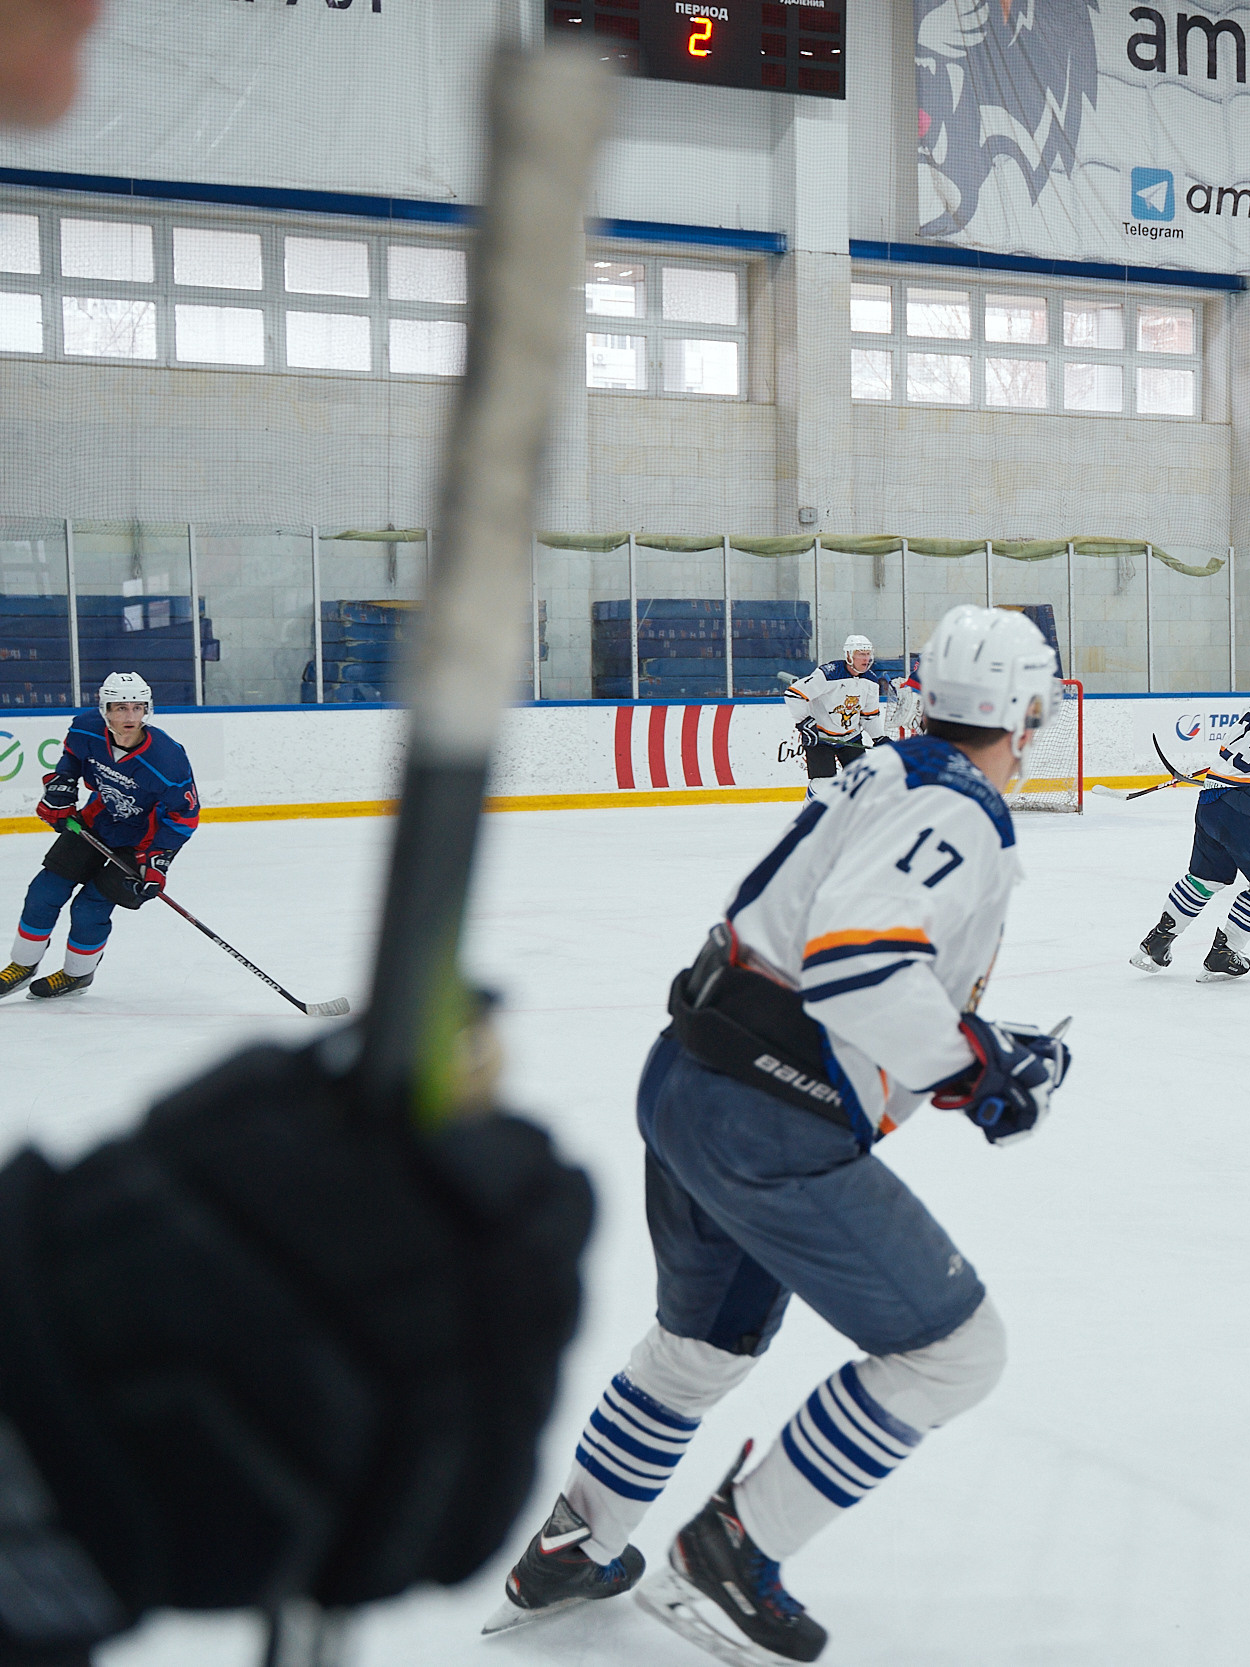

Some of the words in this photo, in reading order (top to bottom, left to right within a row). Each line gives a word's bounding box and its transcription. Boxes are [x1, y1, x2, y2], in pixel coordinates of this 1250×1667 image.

[675, 2, 729, 21] ПЕРИОД
[689, 17, 712, 57] 2
[1122, 222, 1184, 240] Telegram
[1209, 714, 1240, 727] ТРА
[895, 827, 964, 888] 17
